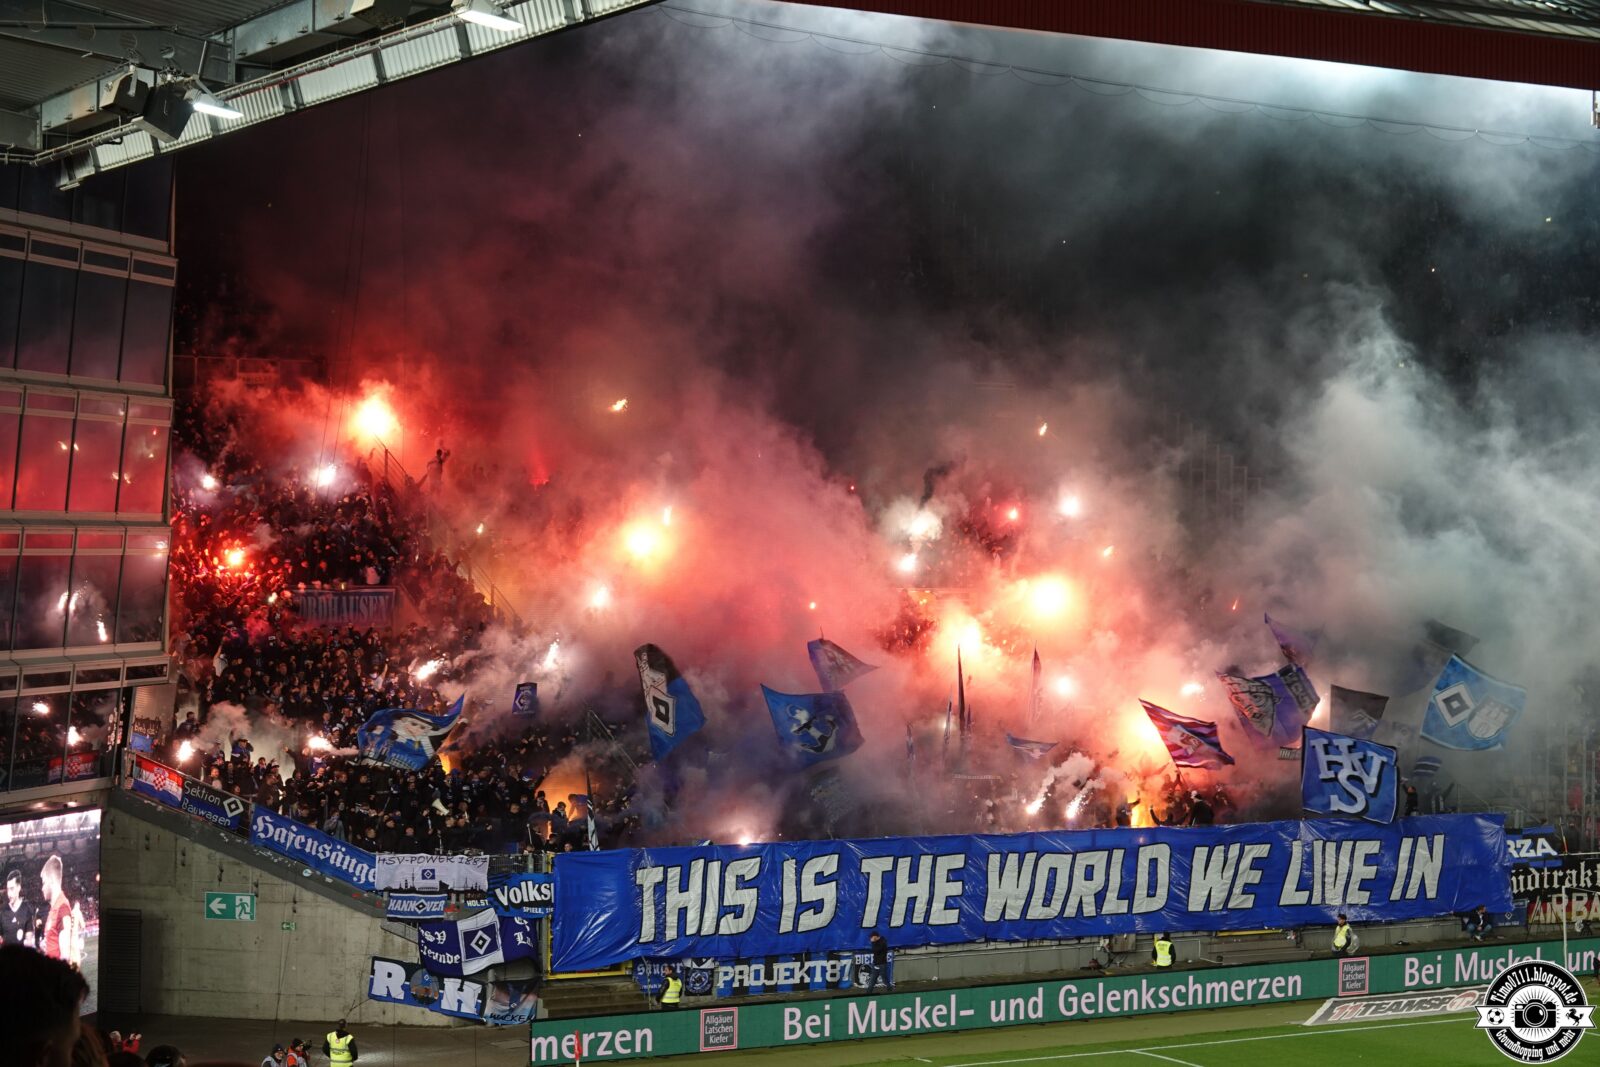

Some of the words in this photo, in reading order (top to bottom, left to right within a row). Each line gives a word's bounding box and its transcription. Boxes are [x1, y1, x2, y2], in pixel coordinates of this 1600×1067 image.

[183, 780, 221, 806] Sektion
[181, 797, 231, 827] Bauwagen
[377, 855, 455, 866] HSV-POWER
[457, 856, 488, 869] 1887
[635, 856, 762, 944] THIS
[778, 852, 840, 935] IS
[860, 853, 966, 928] THE
[983, 841, 1171, 923] WORLD
[1187, 842, 1272, 912] WE
[1278, 839, 1381, 907] LIVE
[1389, 833, 1445, 902] IN
[716, 958, 853, 989] PROJEKT87
[1343, 963, 1366, 974] Allgäuer
[1404, 954, 1442, 987] Bei
[1342, 972, 1366, 982] Latschen
[1345, 981, 1362, 990] Kiefer
[783, 1004, 831, 1041] Bei
[847, 993, 975, 1035] Muskel-
[990, 987, 1044, 1023] und
[1058, 974, 1302, 1017] Gelenkschmerzen
[705, 1014, 734, 1026] Allgäuer
[704, 1023, 734, 1035] Latschen
[709, 1034, 729, 1044] Kiefer
